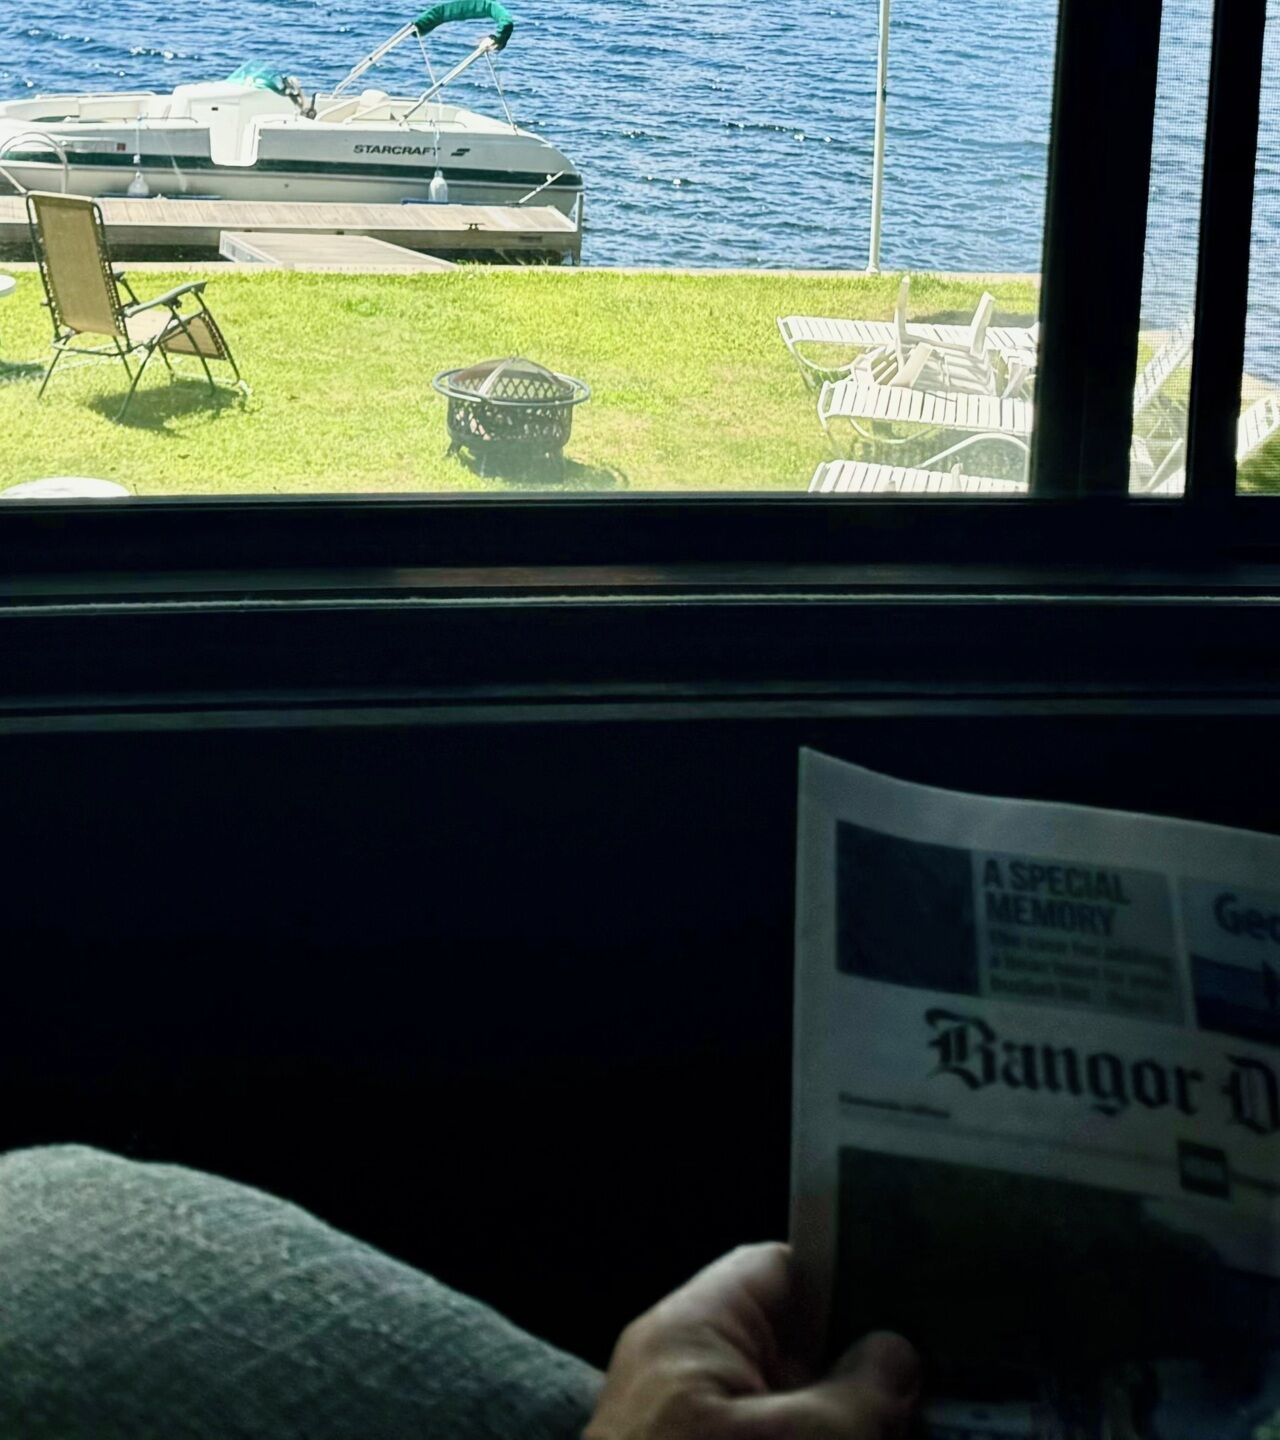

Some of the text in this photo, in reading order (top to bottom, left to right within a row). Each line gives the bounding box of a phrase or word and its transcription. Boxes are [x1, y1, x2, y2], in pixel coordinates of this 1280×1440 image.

[353, 144, 441, 157] STARCRAFT
[984, 859, 1131, 905] A SPECIAL
[986, 891, 1116, 937] MEMORY
[924, 1006, 1205, 1116] Bangor
